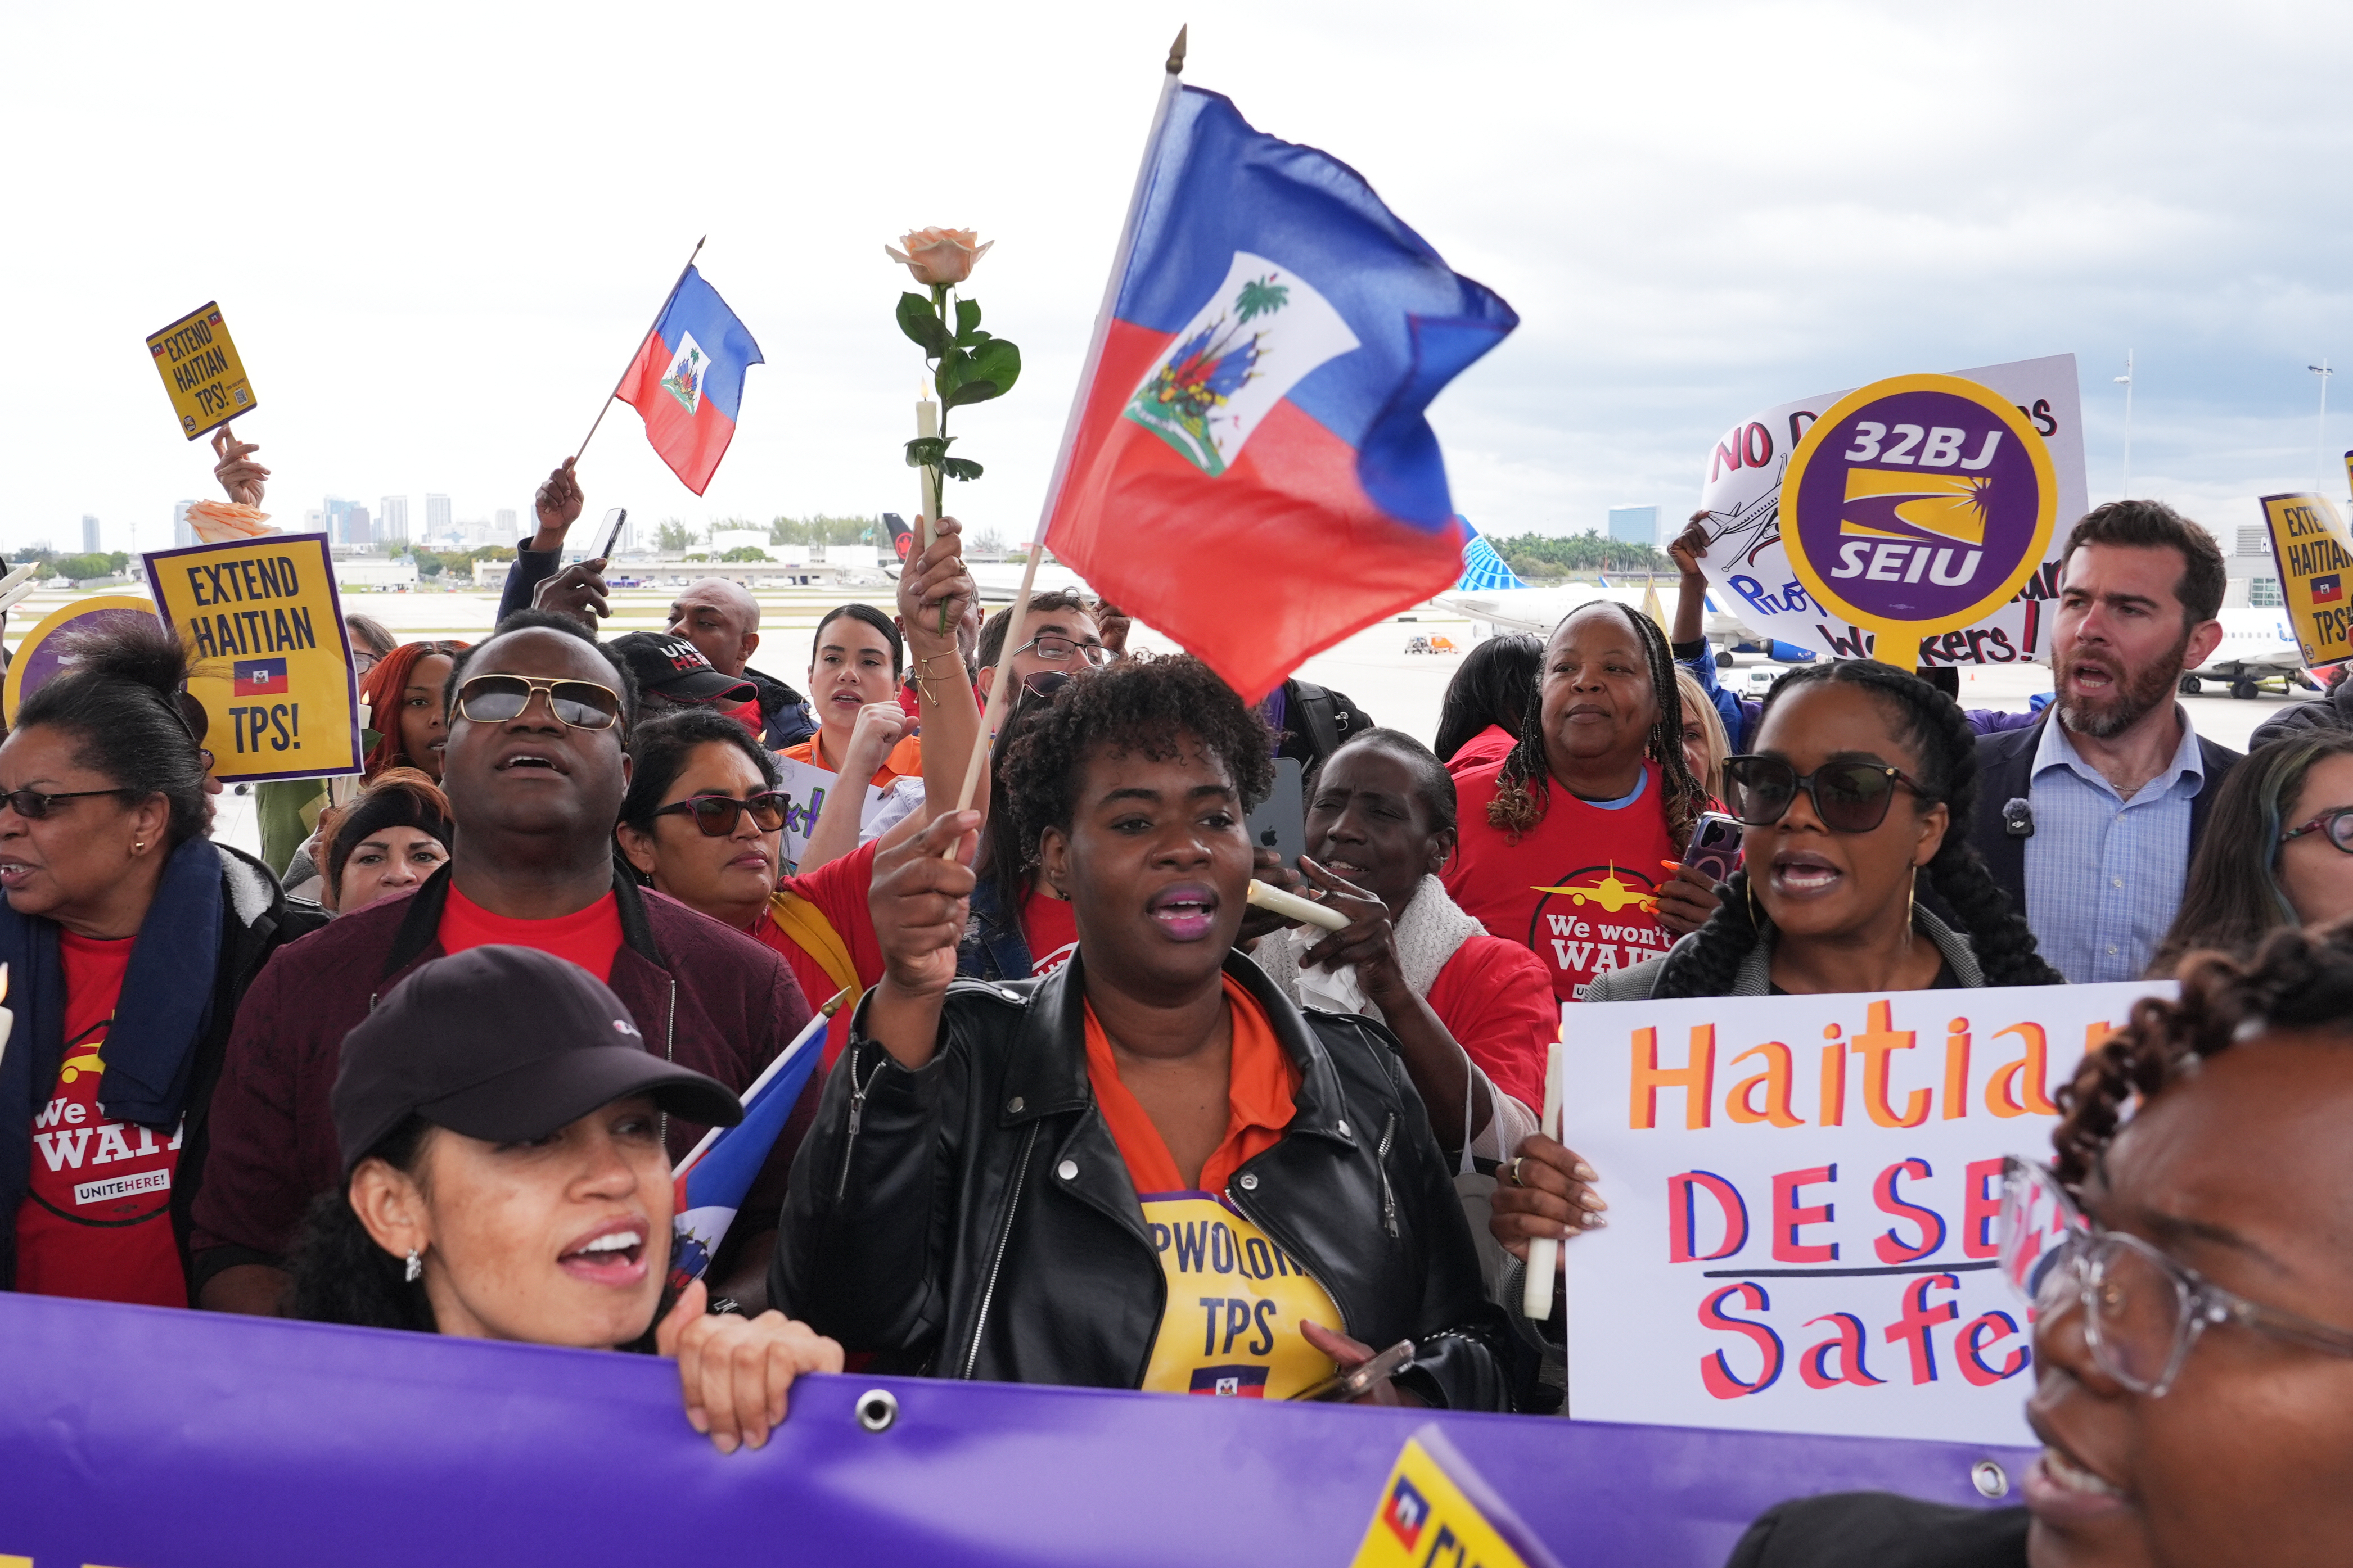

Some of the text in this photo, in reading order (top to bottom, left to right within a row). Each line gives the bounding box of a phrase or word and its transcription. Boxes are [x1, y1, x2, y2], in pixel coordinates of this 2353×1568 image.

[164, 319, 213, 363] EXTEND
[172, 345, 229, 394] HAITIAN
[194, 381, 230, 417] TPS!
[1711, 422, 1773, 484] NO
[1844, 421, 2003, 470] 32BJ
[2283, 506, 2327, 537] EXTE
[187, 557, 299, 607] EXTEND
[1830, 541, 1984, 587] SEIU
[190, 607, 316, 658] HAITIAN
[1815, 599, 2040, 666] Wkers!
[229, 703, 301, 753] TPS!
[1547, 914, 1590, 938] We
[35, 1097, 87, 1129] We
[33, 1119, 183, 1172] WAI
[1199, 1296, 1277, 1357] TPS
[1698, 1272, 2033, 1400] Safe
